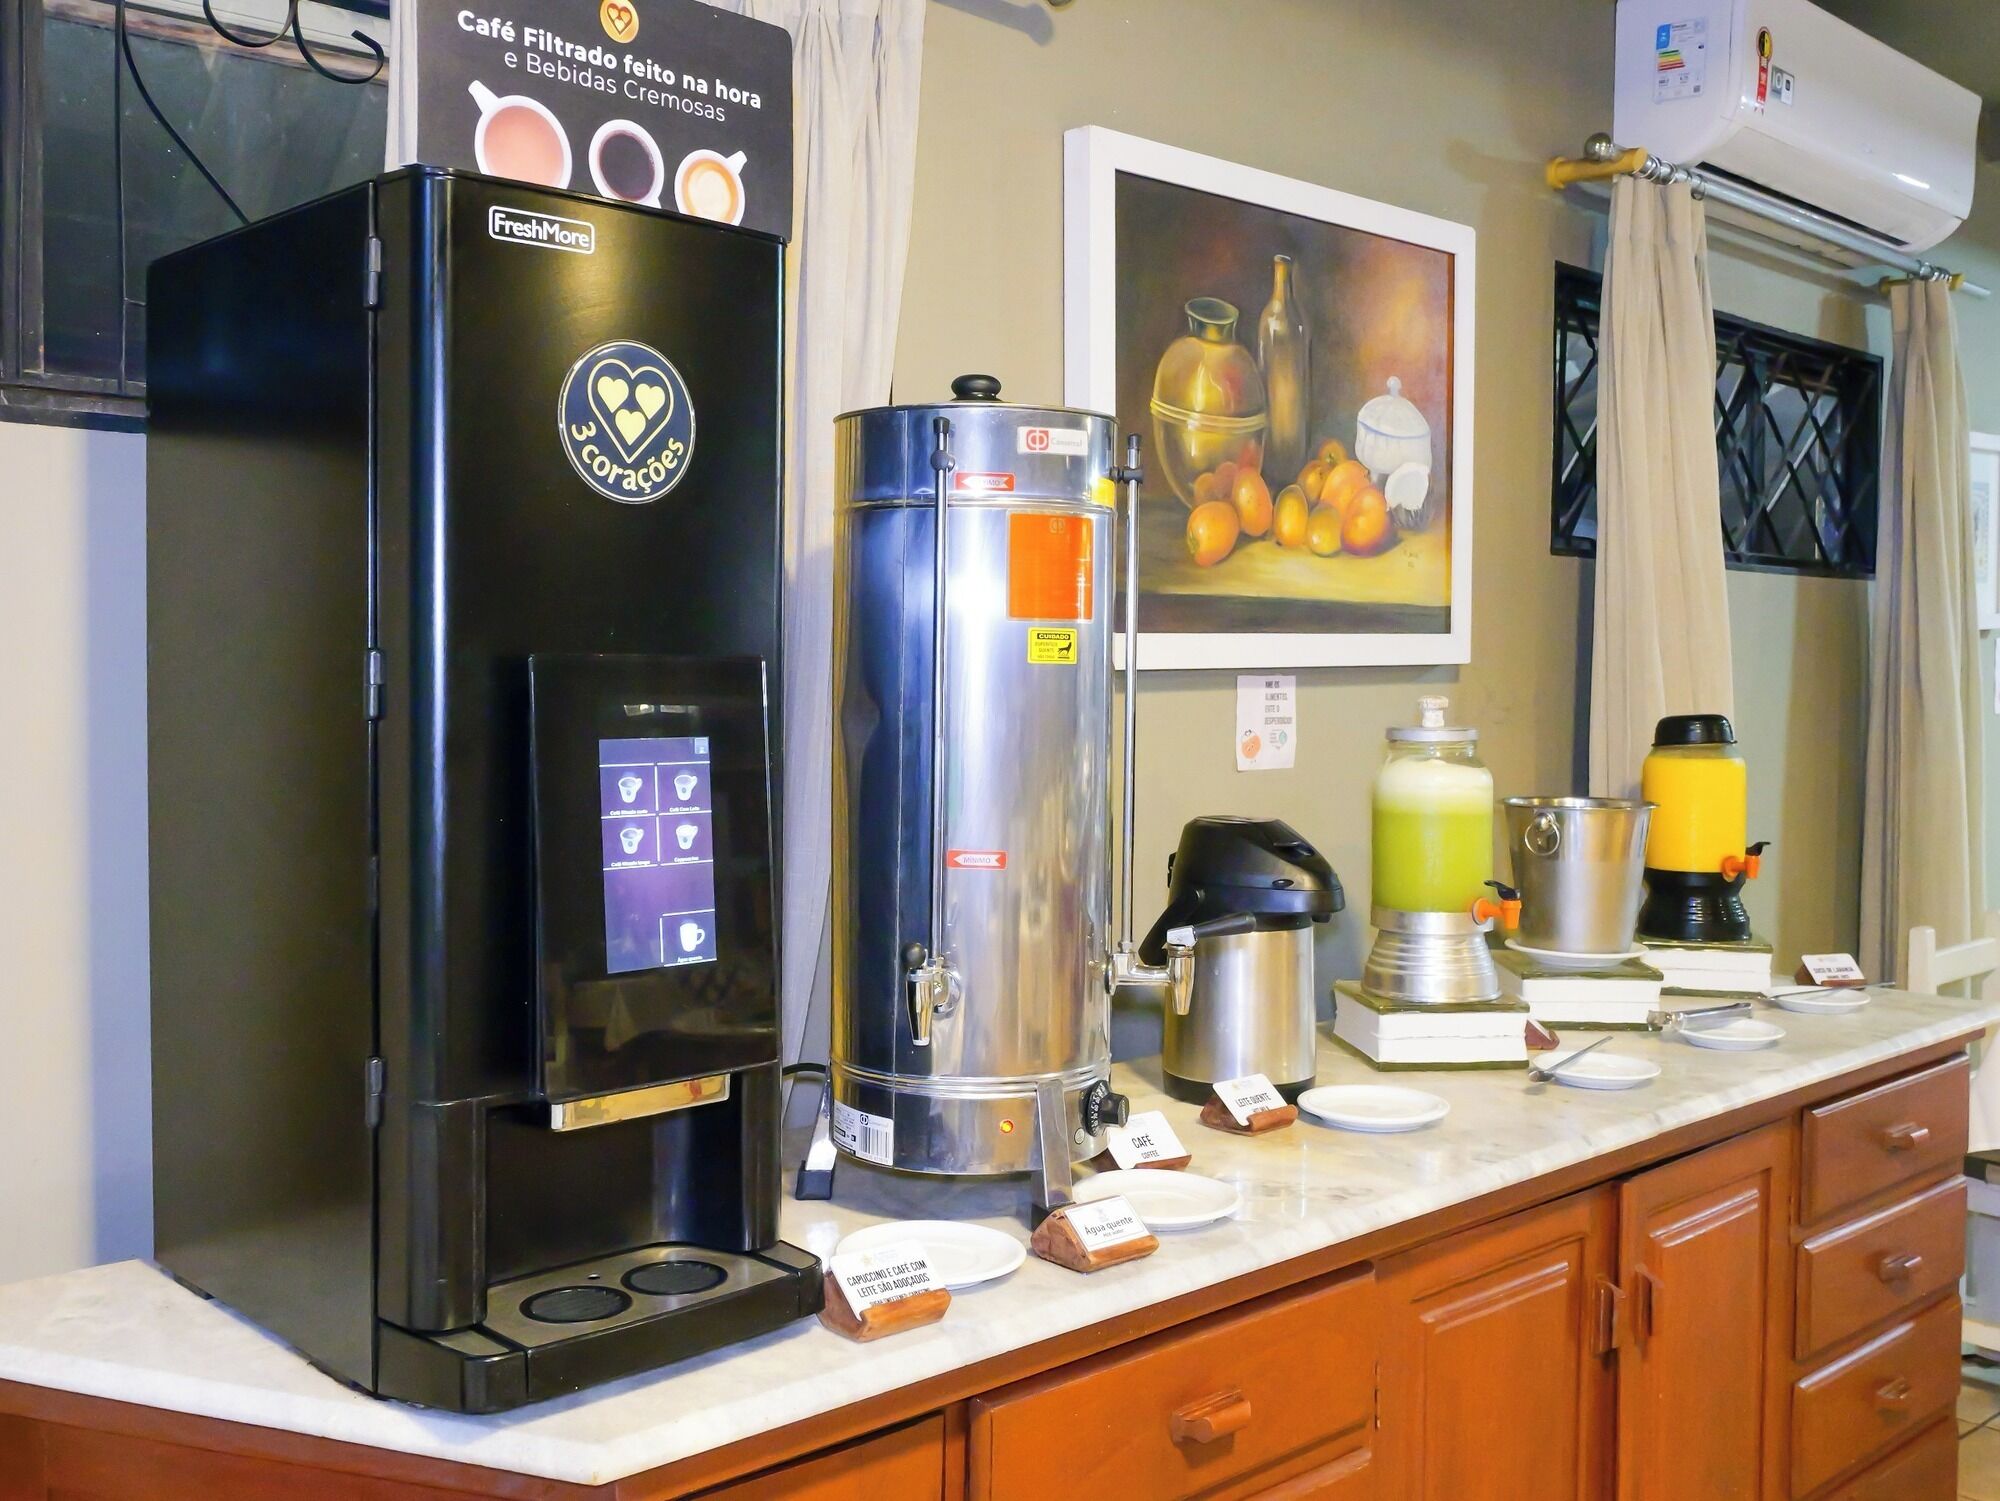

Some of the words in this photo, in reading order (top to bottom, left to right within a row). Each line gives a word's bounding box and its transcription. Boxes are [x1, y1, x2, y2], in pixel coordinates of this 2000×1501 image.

[457, 10, 516, 43] Café
[523, 26, 618, 69] Filtrado
[623, 54, 676, 86] feito
[682, 74, 708, 95] na
[715, 79, 762, 109] hora
[504, 50, 518, 68] e
[526, 52, 617, 94] Bebidas
[623, 80, 726, 122] Cremosas
[493, 213, 590, 248] FreshMore
[571, 421, 597, 442] 3
[581, 437, 684, 494] corações
[1106, 1214, 1134, 1231] quente
[846, 1267, 887, 1287] CAPUCCINO
[887, 1267, 894, 1278] E
[910, 1259, 928, 1272] COM
[856, 1284, 878, 1298] LEITE
[876, 1280, 894, 1294] SÃO
[893, 1272, 931, 1290] ADOÇADOS
